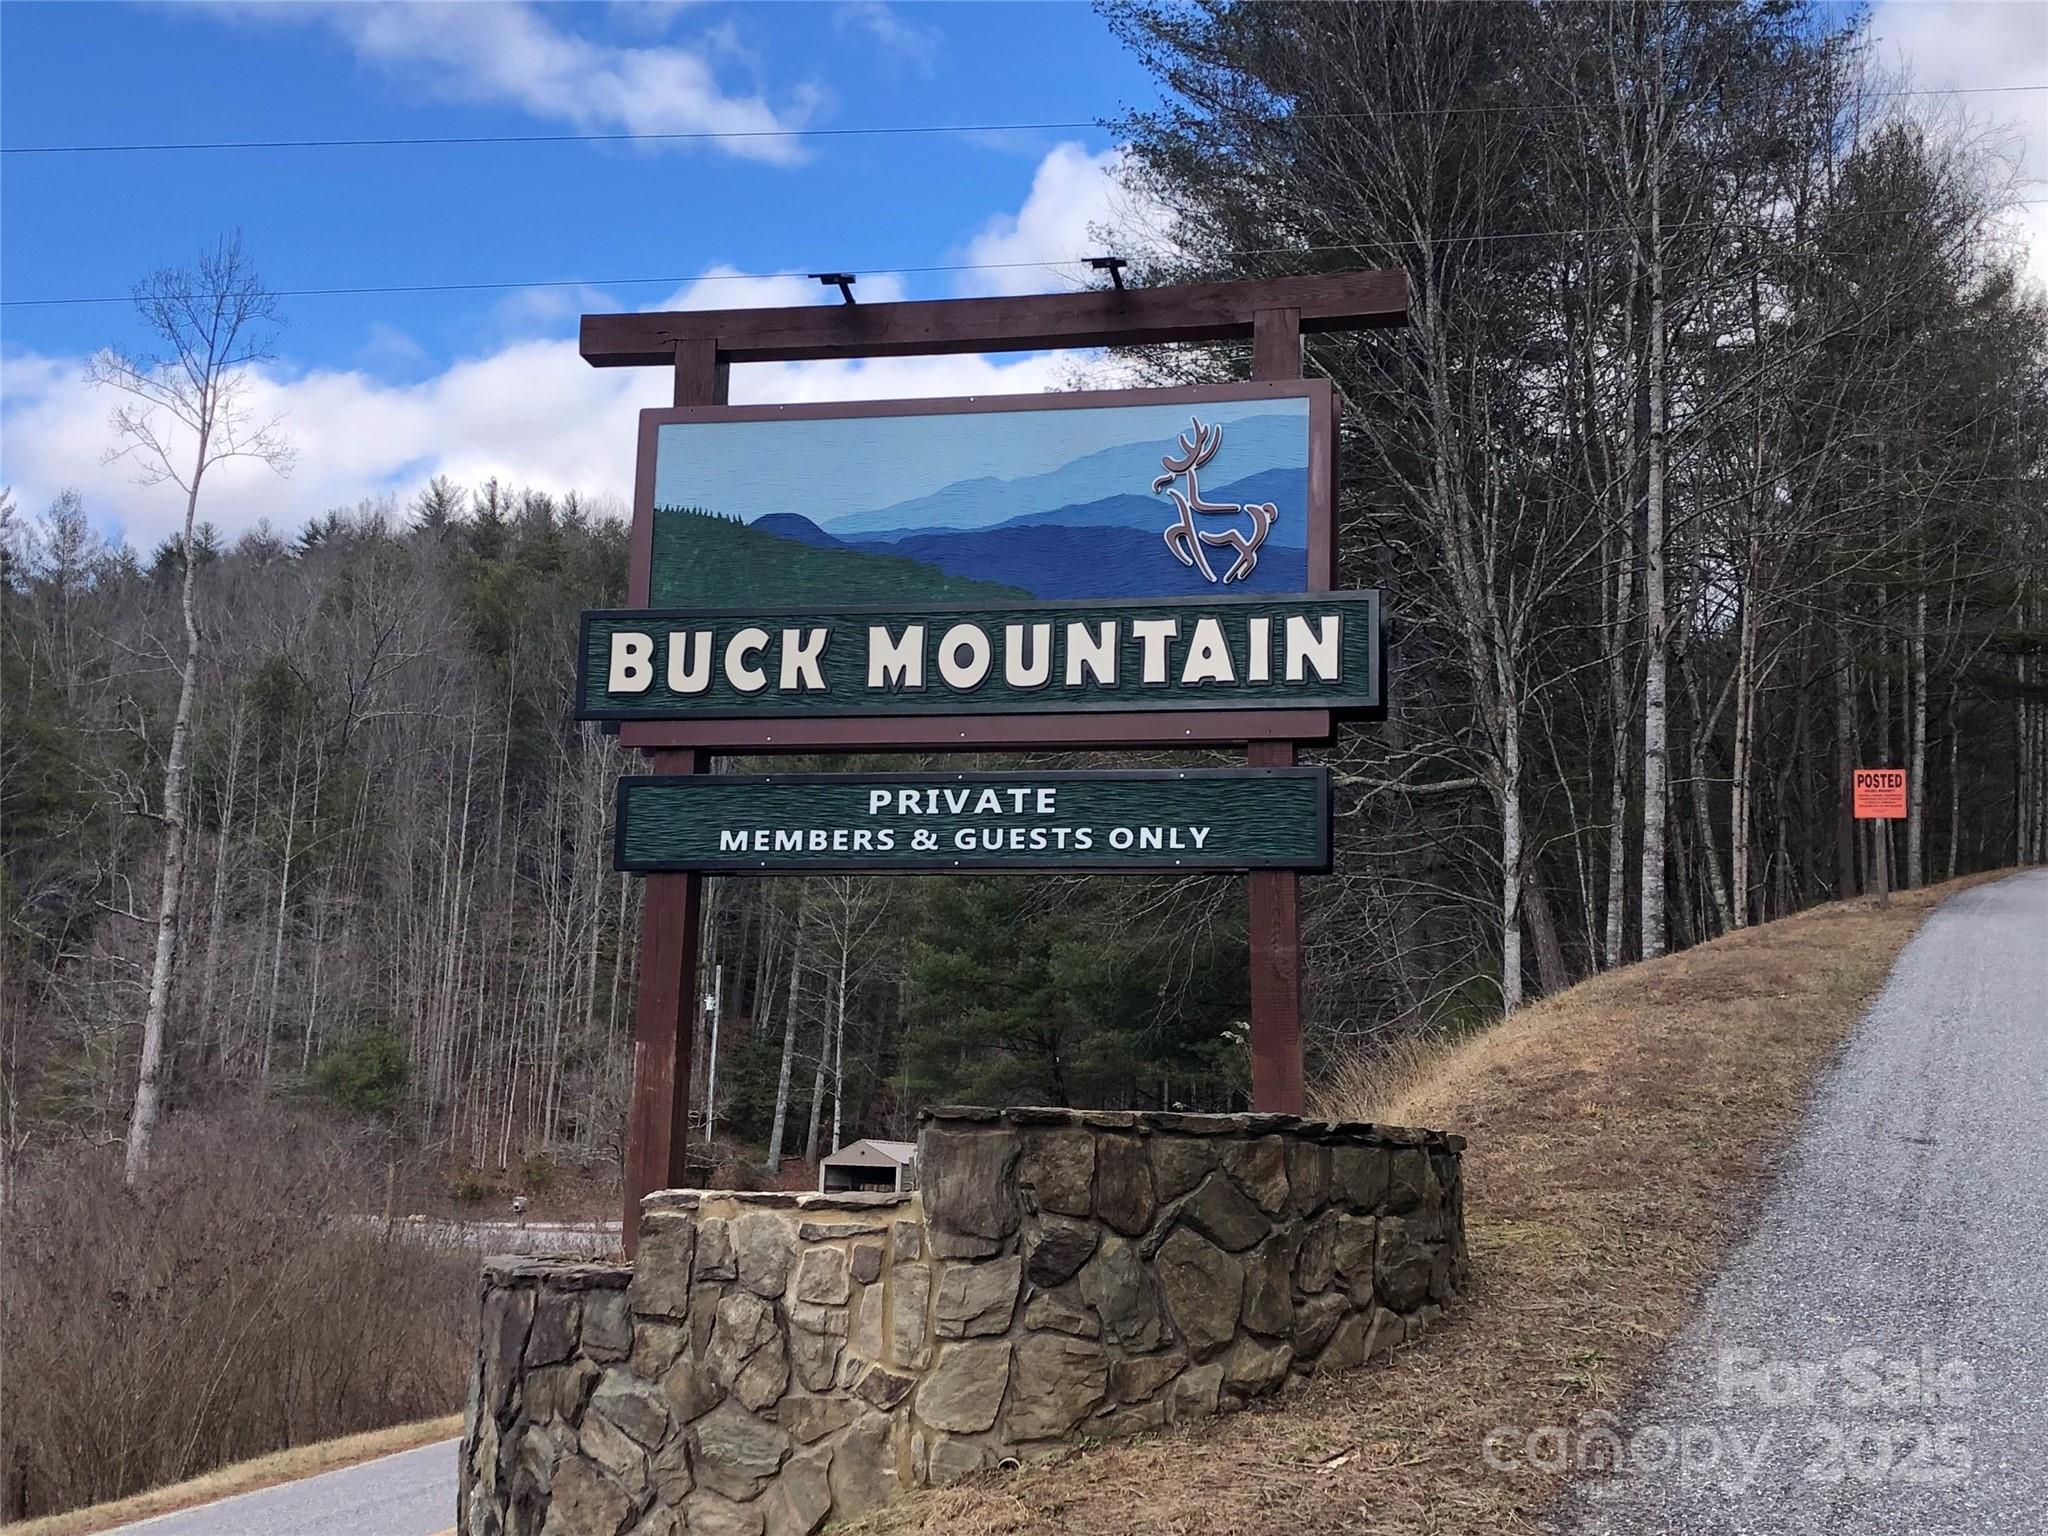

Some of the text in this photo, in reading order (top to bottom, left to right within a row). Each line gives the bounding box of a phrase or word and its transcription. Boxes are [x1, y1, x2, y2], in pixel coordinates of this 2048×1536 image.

[607, 615, 1340, 693] BUCK MOUNTAIN
[1857, 773, 1902, 788] POSTED
[868, 788, 1056, 815] PRIVATE
[719, 826, 1212, 852] MEMBERS & GUESTS ONLY
